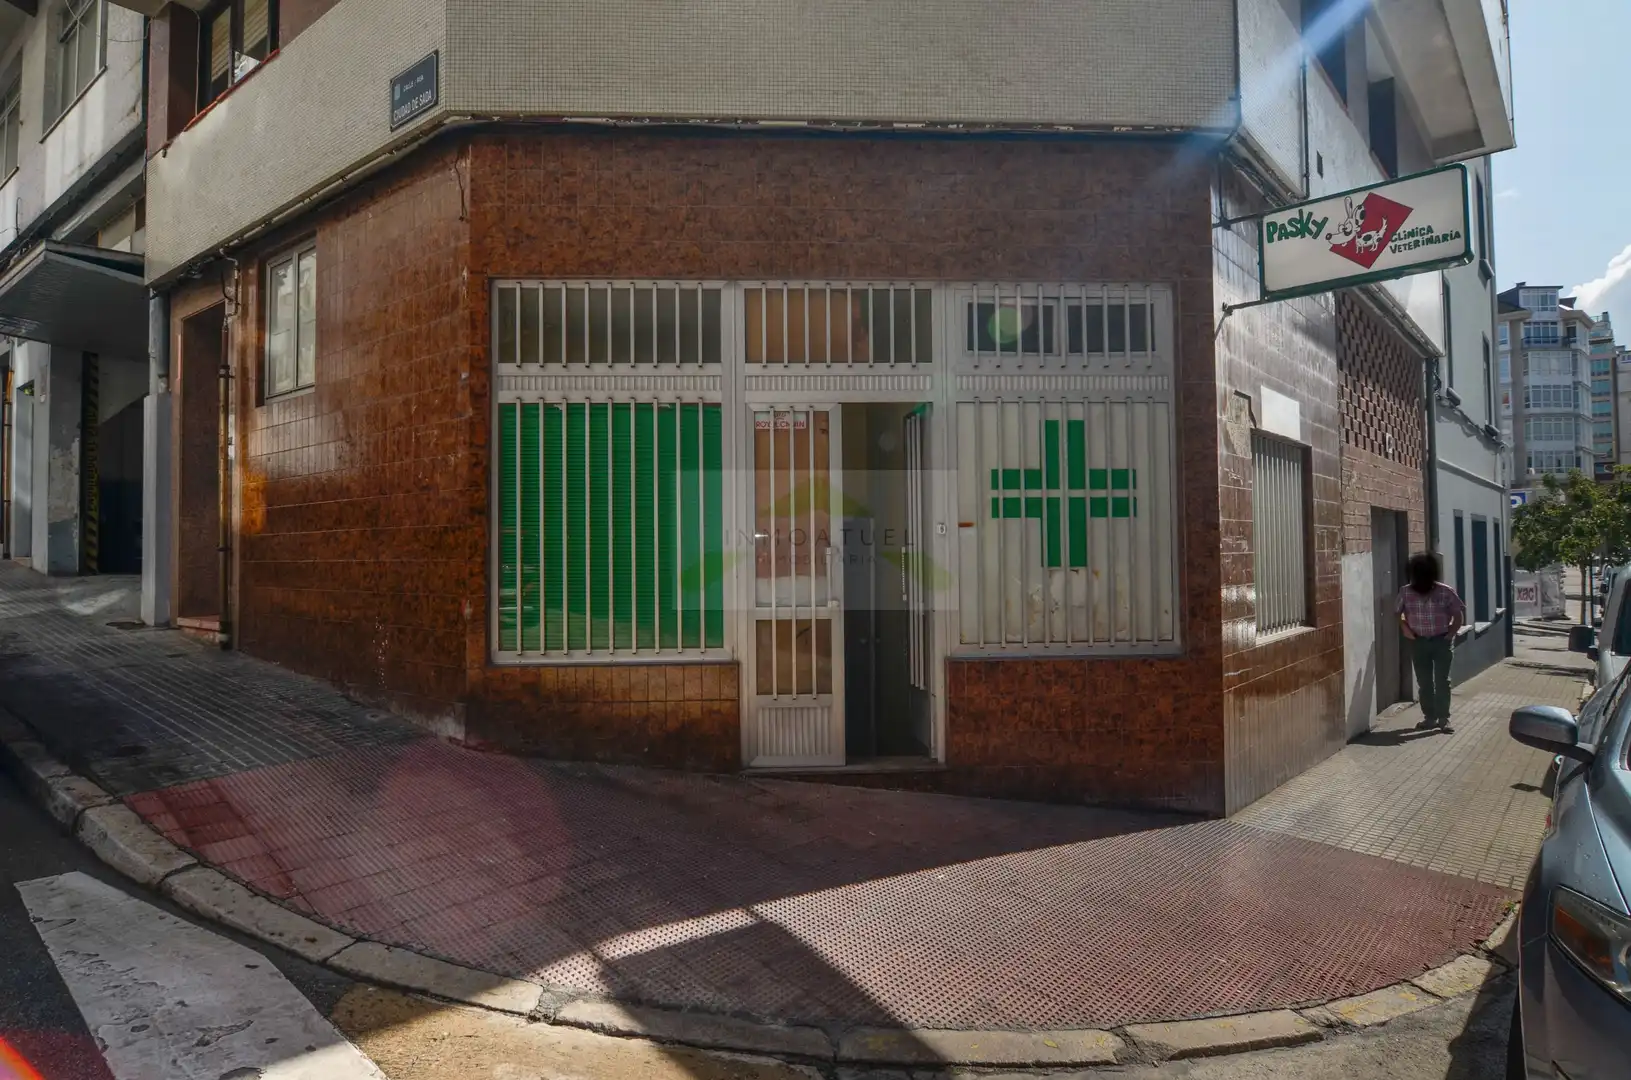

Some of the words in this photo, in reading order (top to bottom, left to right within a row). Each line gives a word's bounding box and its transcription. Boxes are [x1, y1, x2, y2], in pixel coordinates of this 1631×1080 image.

[394, 102, 411, 122] CIUDAD
[411, 97, 418, 110] DE
[419, 88, 432, 106] SADA
[1266, 209, 1329, 243] PASKY
[756, 420, 780, 428] ROYL
